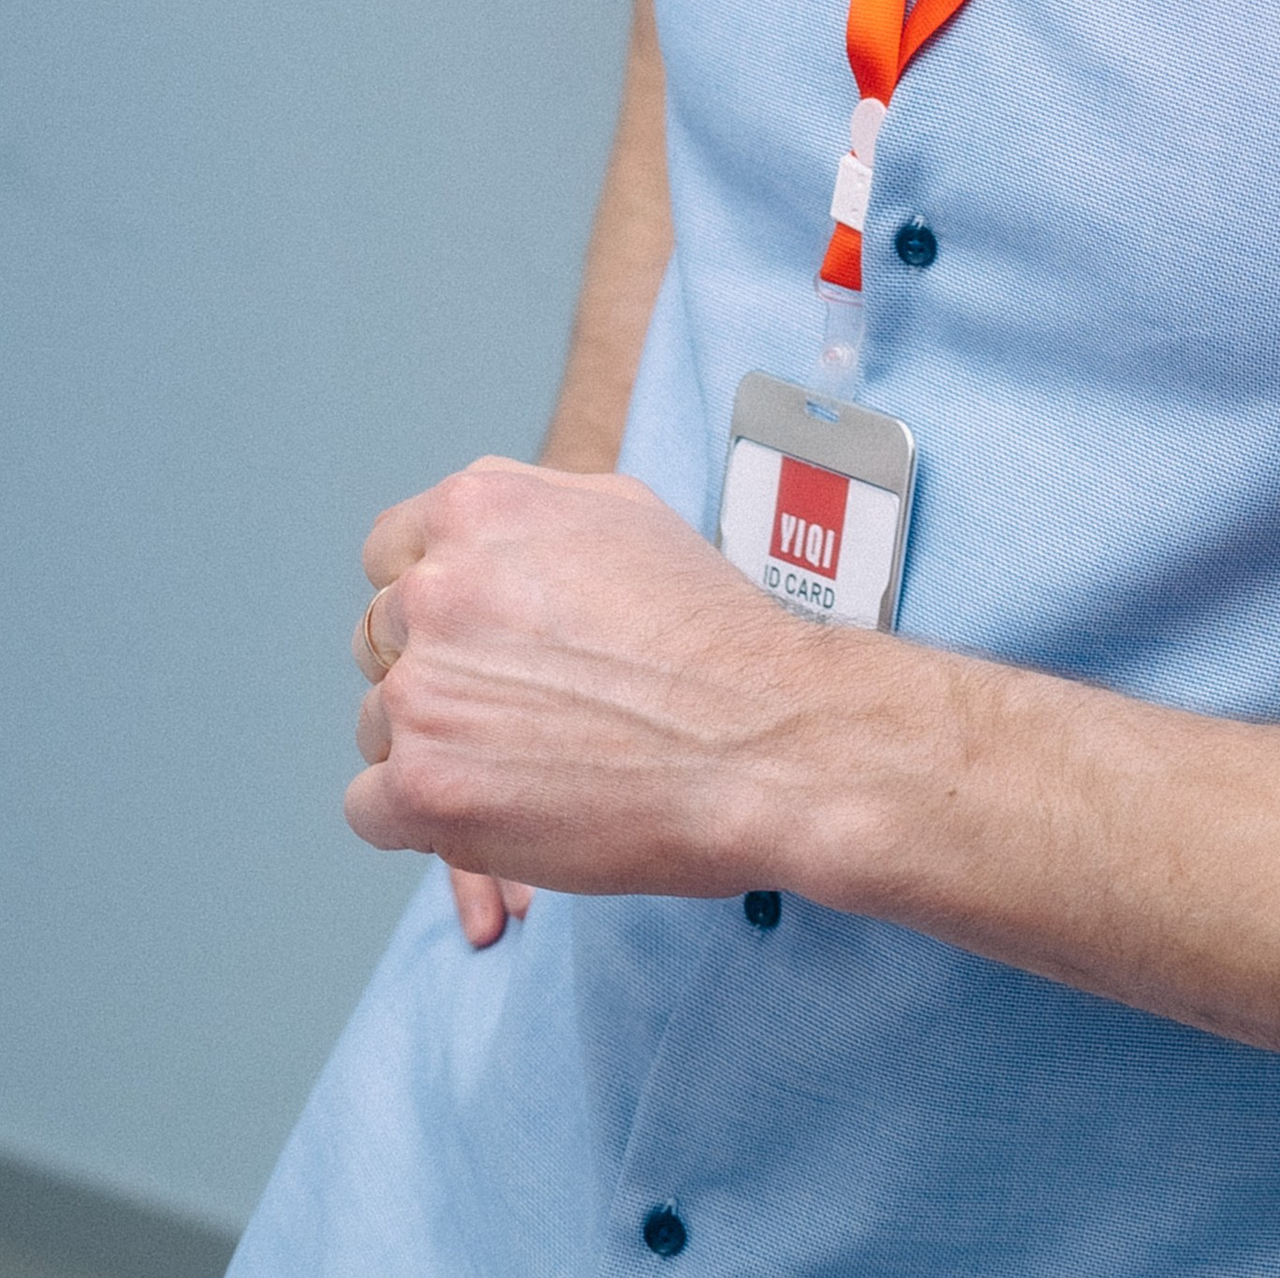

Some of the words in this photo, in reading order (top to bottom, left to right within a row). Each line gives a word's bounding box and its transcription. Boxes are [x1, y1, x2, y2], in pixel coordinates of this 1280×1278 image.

[781, 512, 835, 569] YIQI
[763, 564, 780, 588] ID
[785, 573, 835, 609] CARD
